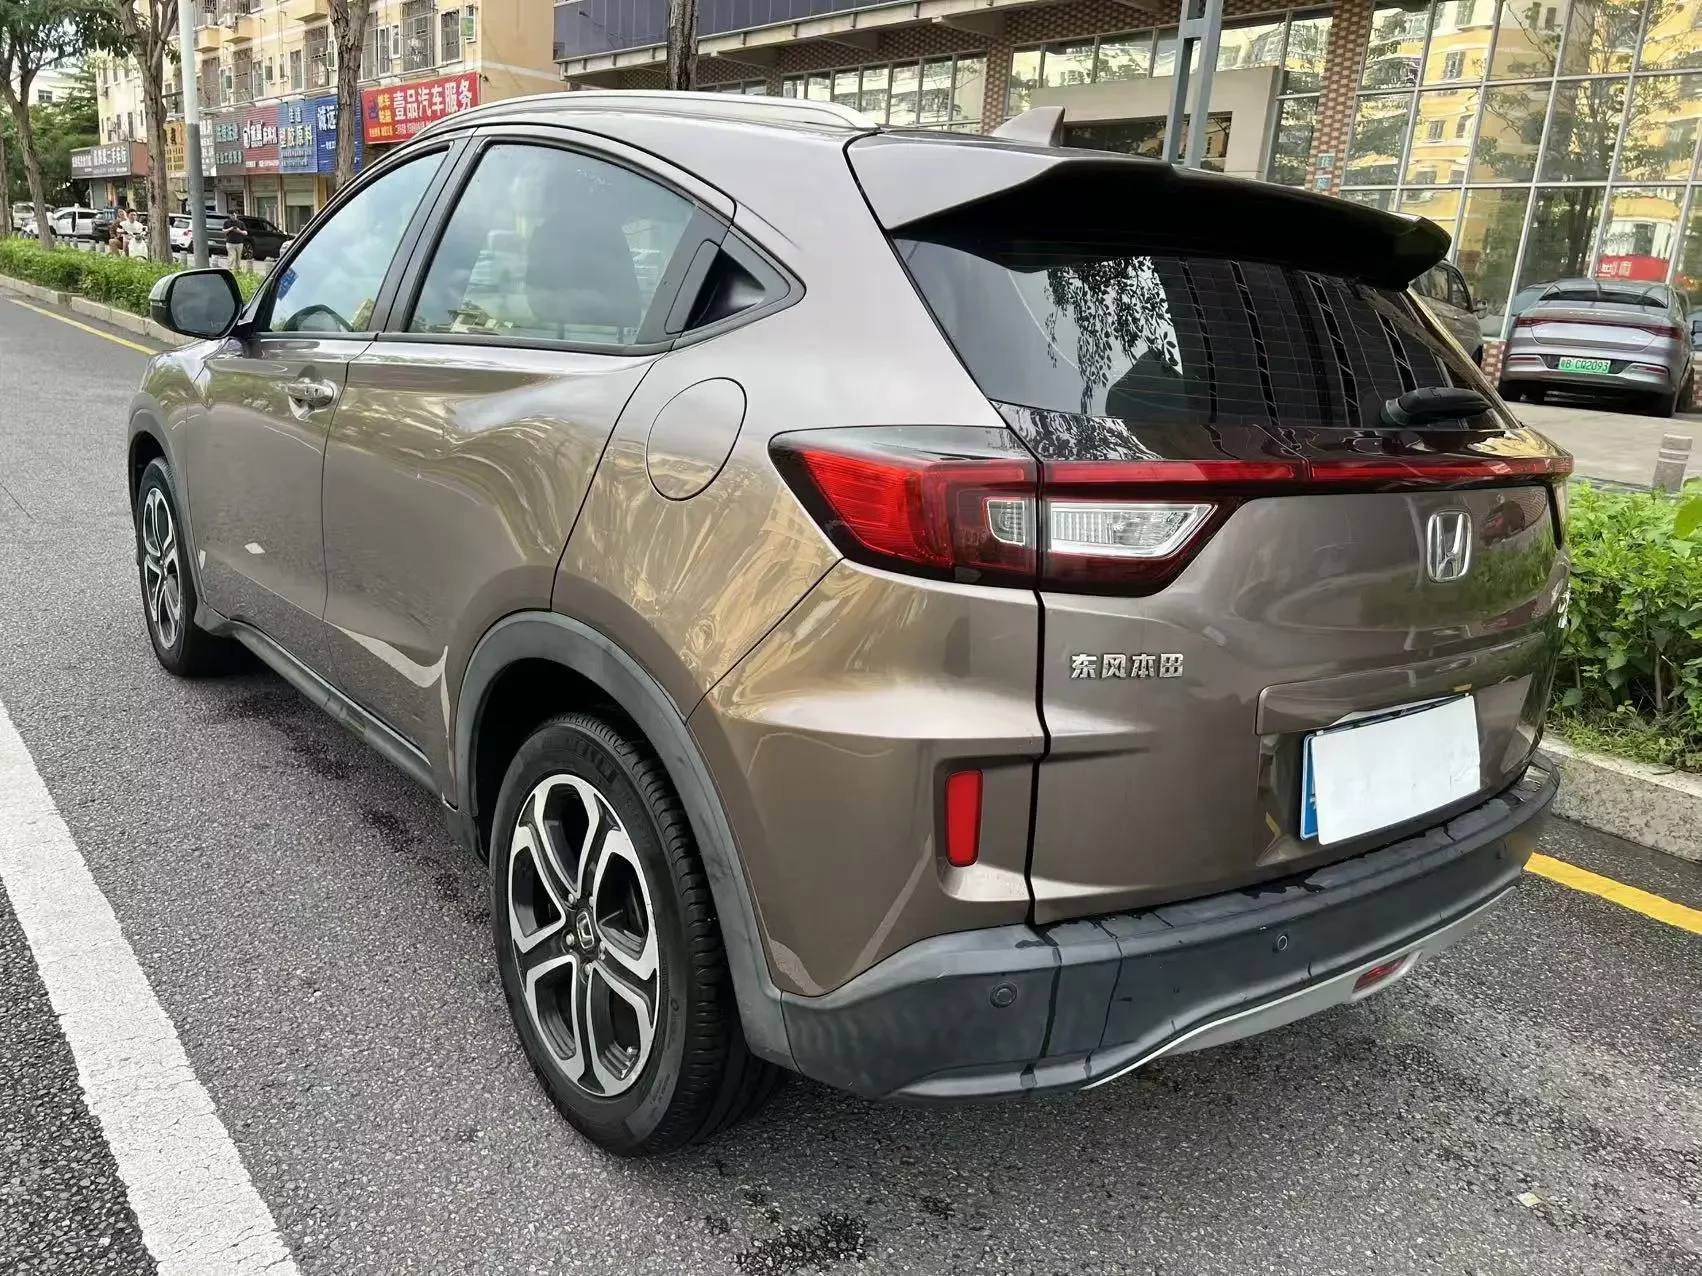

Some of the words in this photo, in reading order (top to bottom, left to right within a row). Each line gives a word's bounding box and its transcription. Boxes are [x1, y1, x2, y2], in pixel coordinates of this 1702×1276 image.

[393, 80, 473, 121] 壹品汽车服务
[317, 104, 339, 131] 诚远
[1071, 653, 1184, 679] 东风本田
